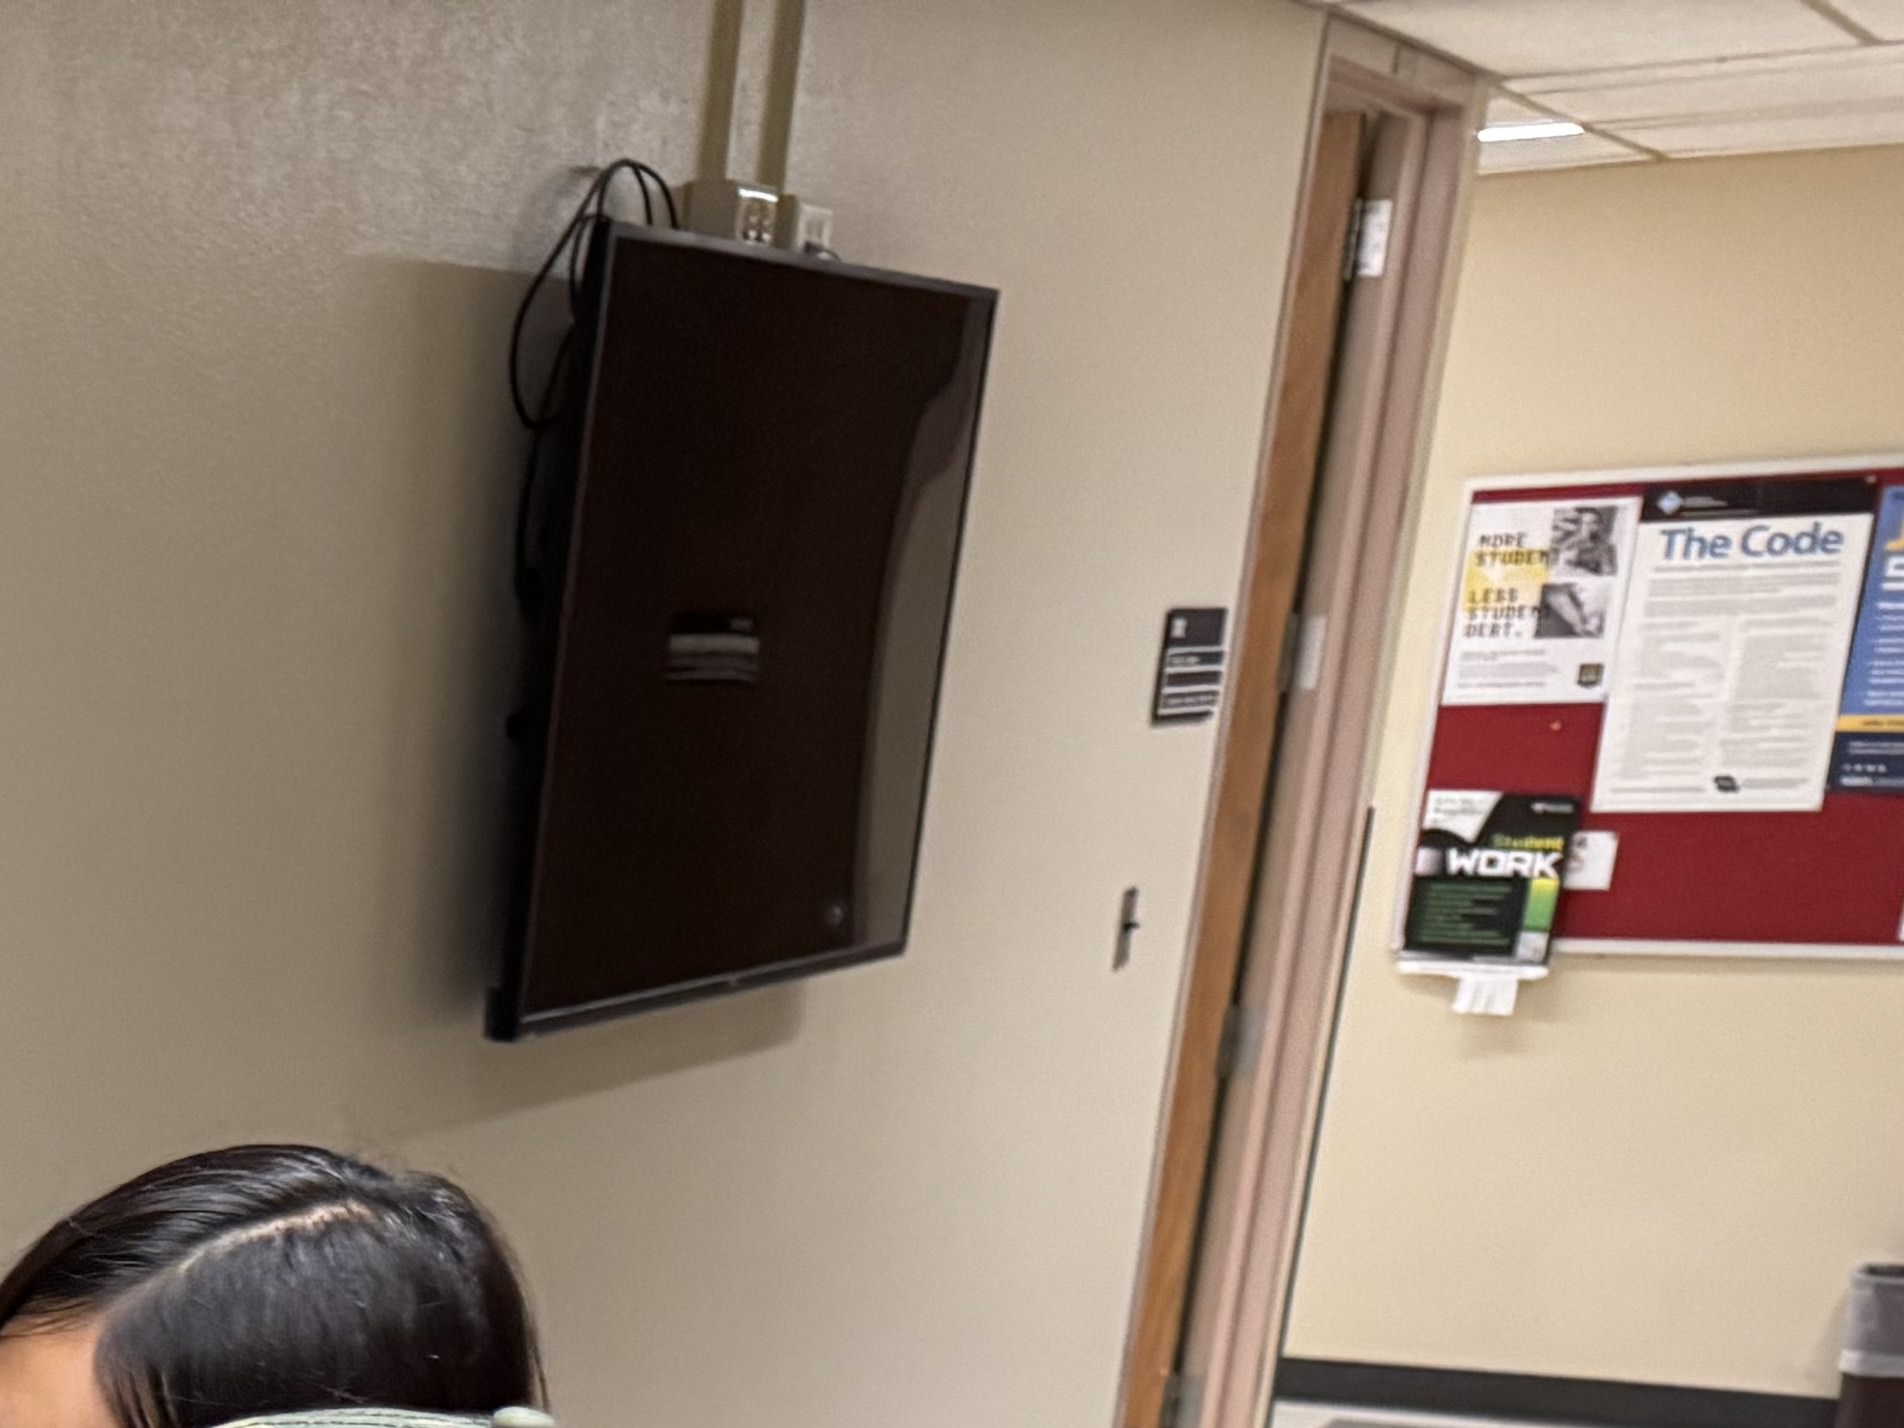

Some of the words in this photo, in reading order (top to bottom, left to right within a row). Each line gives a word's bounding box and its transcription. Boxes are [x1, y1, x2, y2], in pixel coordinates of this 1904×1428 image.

[1479, 532, 1528, 547] MORE
[1658, 527, 1732, 561] The
[1740, 522, 1844, 559] Code
[1467, 587, 1519, 604] LESS
[1492, 832, 1565, 851] Student
[1446, 846, 1564, 879] WORK
